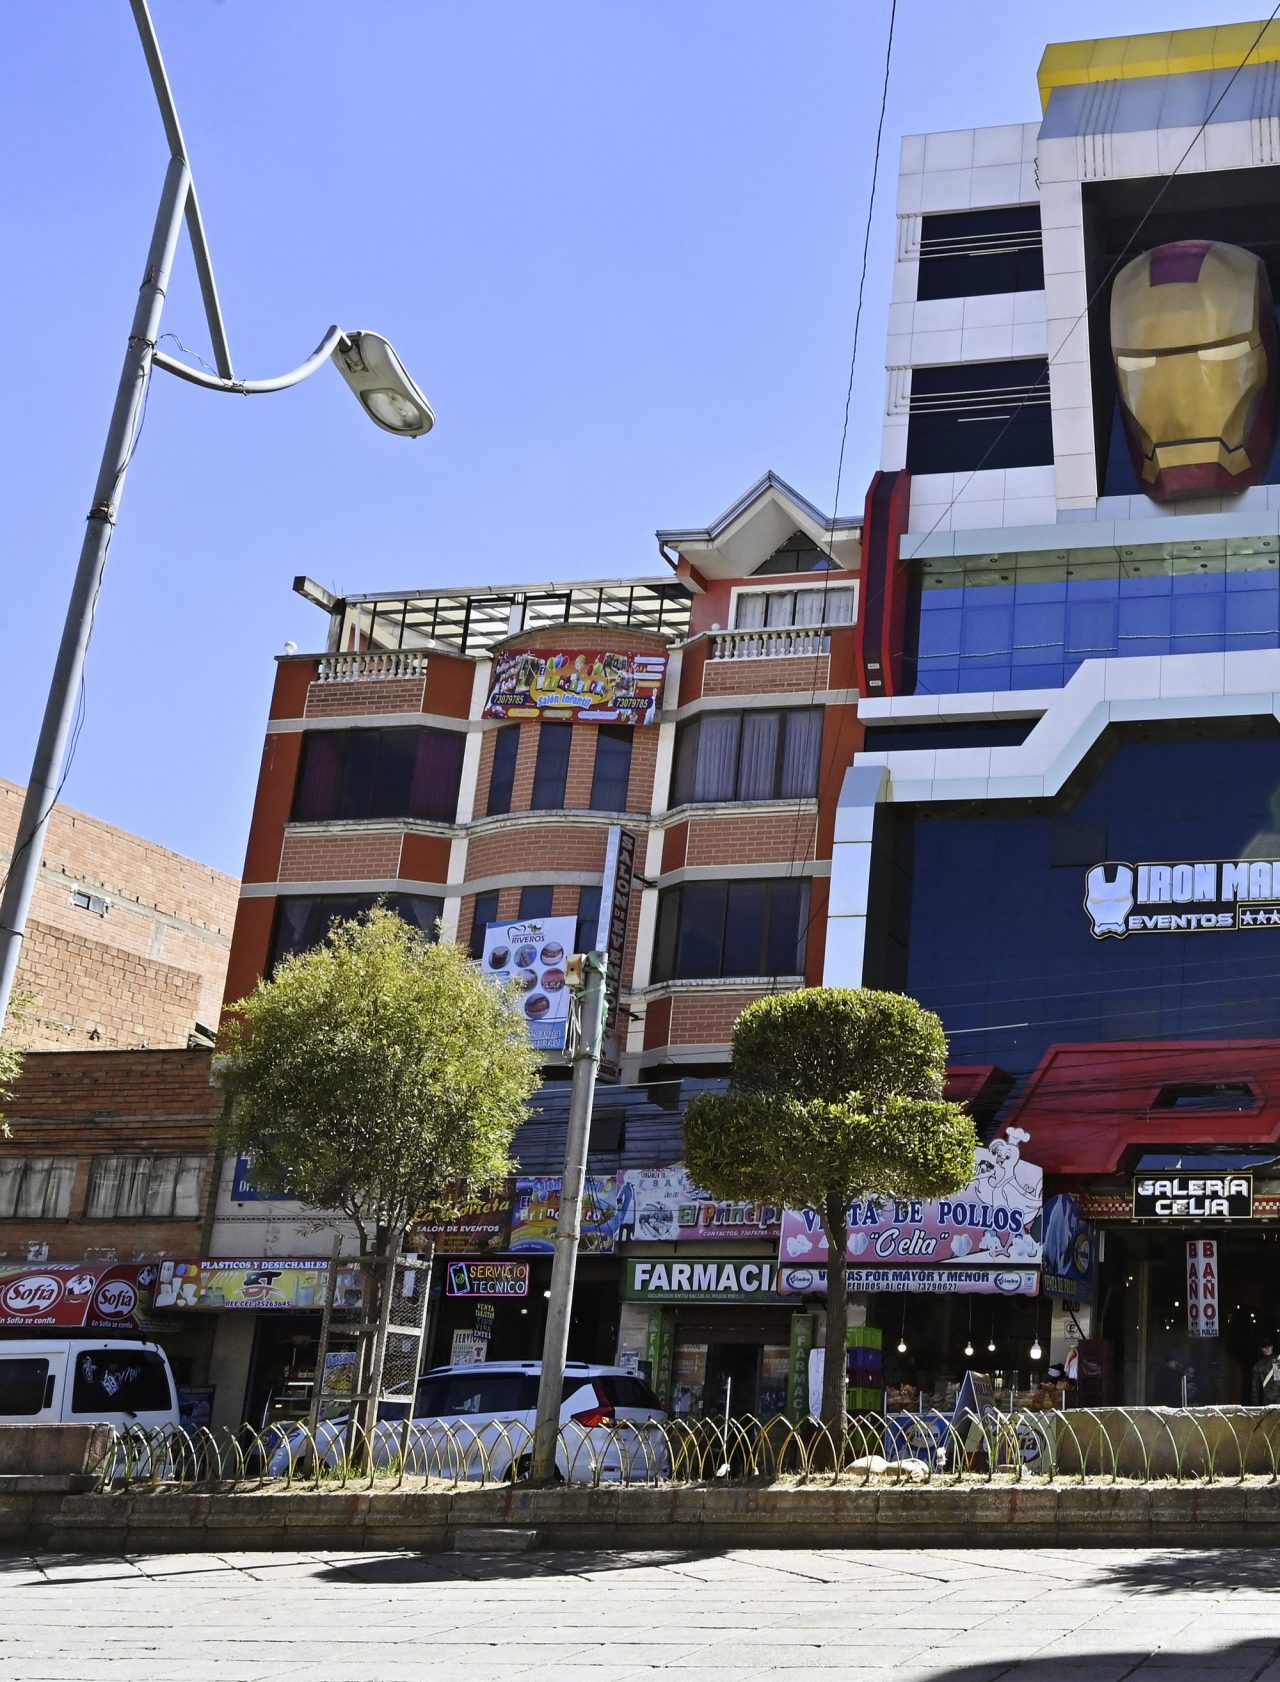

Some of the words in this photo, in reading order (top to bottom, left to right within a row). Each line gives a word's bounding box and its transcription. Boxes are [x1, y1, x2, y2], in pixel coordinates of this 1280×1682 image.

[614, 834, 634, 907] SALON
[1137, 863, 1217, 905] IRON
[1128, 912, 1234, 930] EVENTOS
[511, 935, 545, 944] RIVEROS
[1137, 1175, 1249, 1198] GALERÍA
[677, 1203, 700, 1228] El
[1155, 1197, 1230, 1217] CELIA
[801, 1202, 879, 1233] VTA
[938, 1201, 1024, 1233] POLLOS
[416, 1225, 445, 1233] SALON
[200, 1261, 251, 1269] PLASTICOS
[253, 1261, 260, 1269] Y
[261, 1261, 328, 1269] DESECHABLES
[469, 1265, 526, 1278] SERVICIO
[847, 1282, 881, 1290] PEDIDOS
[885, 1282, 895, 1290] AL
[865, 1271, 891, 1282] POR
[891, 1270, 935, 1282] MAYOR
[936, 1271, 945, 1282] Y
[949, 1271, 990, 1283] MENOR
[1202, 1241, 1217, 1321] BAÑO
[9, 1282, 55, 1304] Sofía
[472, 1281, 525, 1293] TECNICO
[99, 1290, 133, 1309] Sofía
[474, 1330, 492, 1339] ENTEL
[792, 1336, 807, 1421] FARMACI
